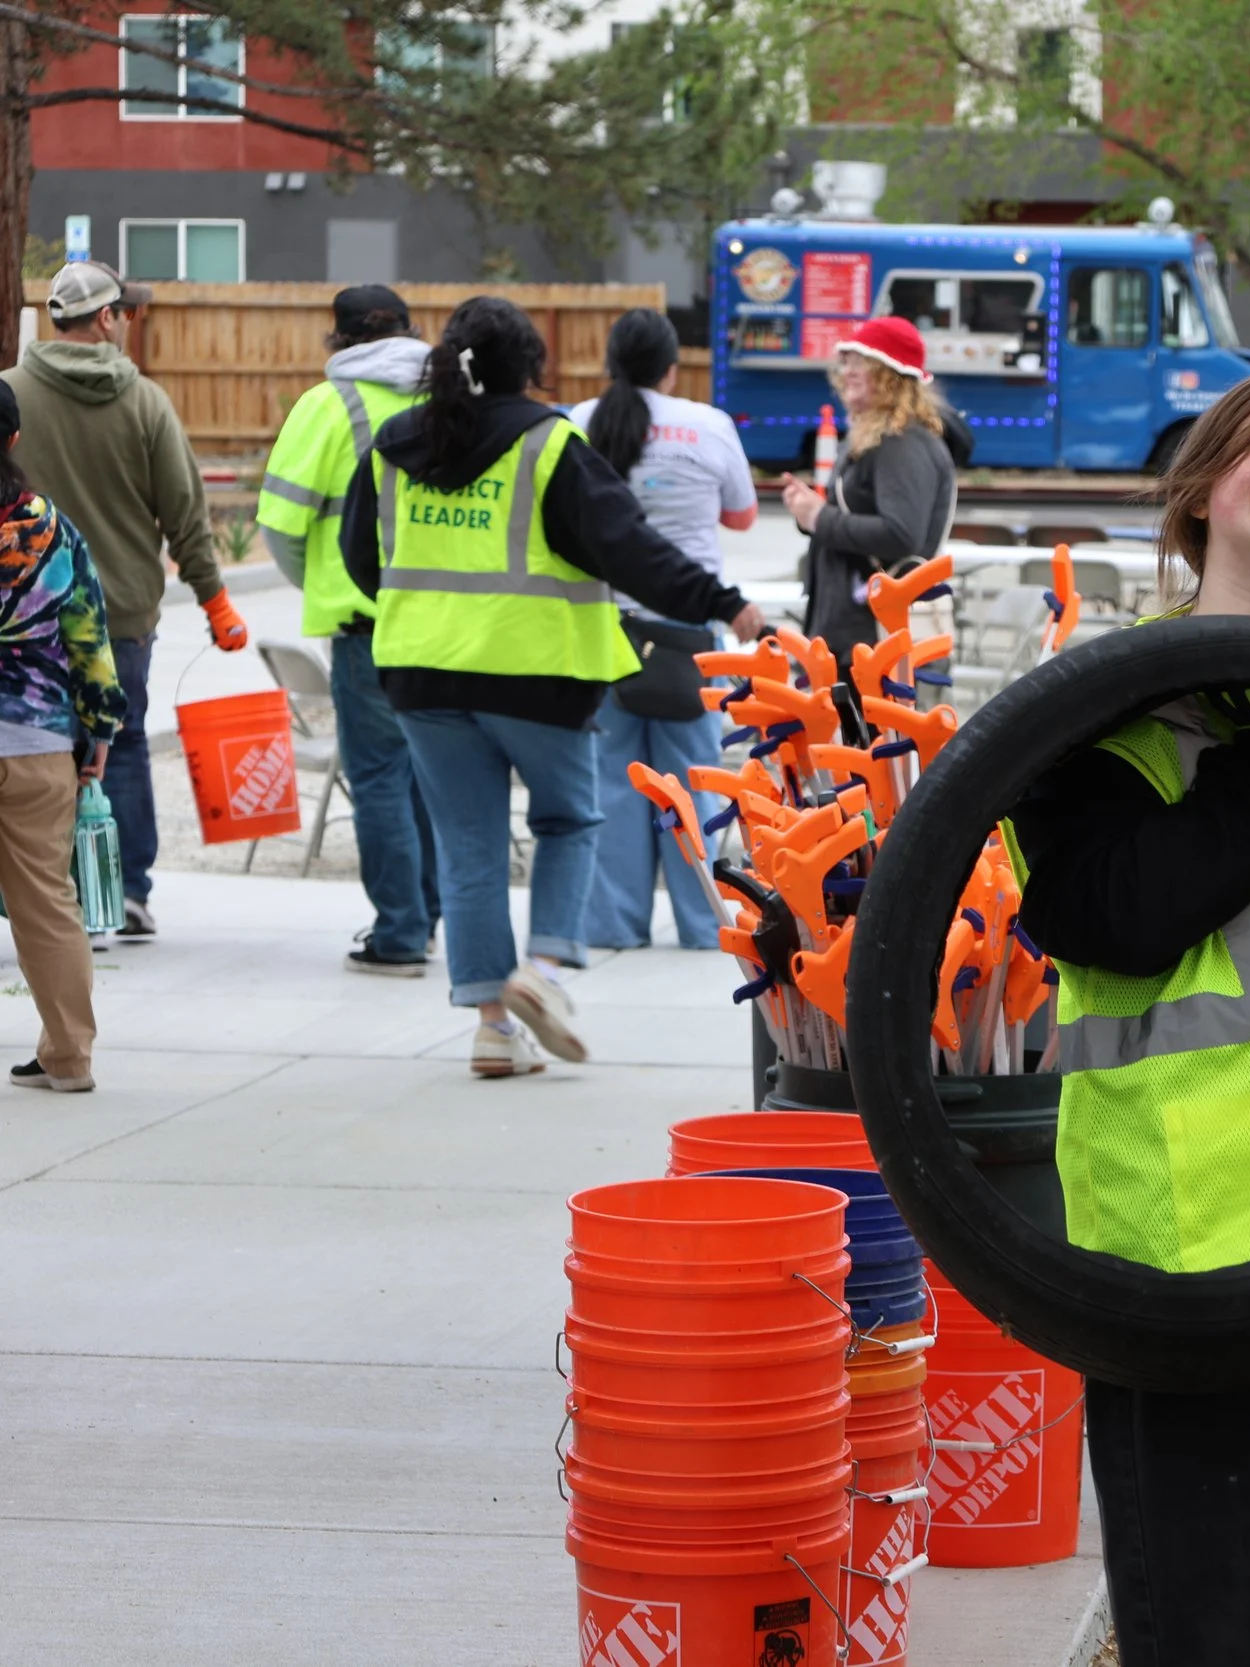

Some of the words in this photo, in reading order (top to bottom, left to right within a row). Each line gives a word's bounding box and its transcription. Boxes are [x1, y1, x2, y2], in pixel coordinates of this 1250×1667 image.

[409, 503, 492, 530] LEADER
[929, 1388, 970, 1438] HE
[949, 1428, 1041, 1525] DEPOT
[864, 1505, 911, 1579] THE
[849, 1537, 912, 1664] HO
